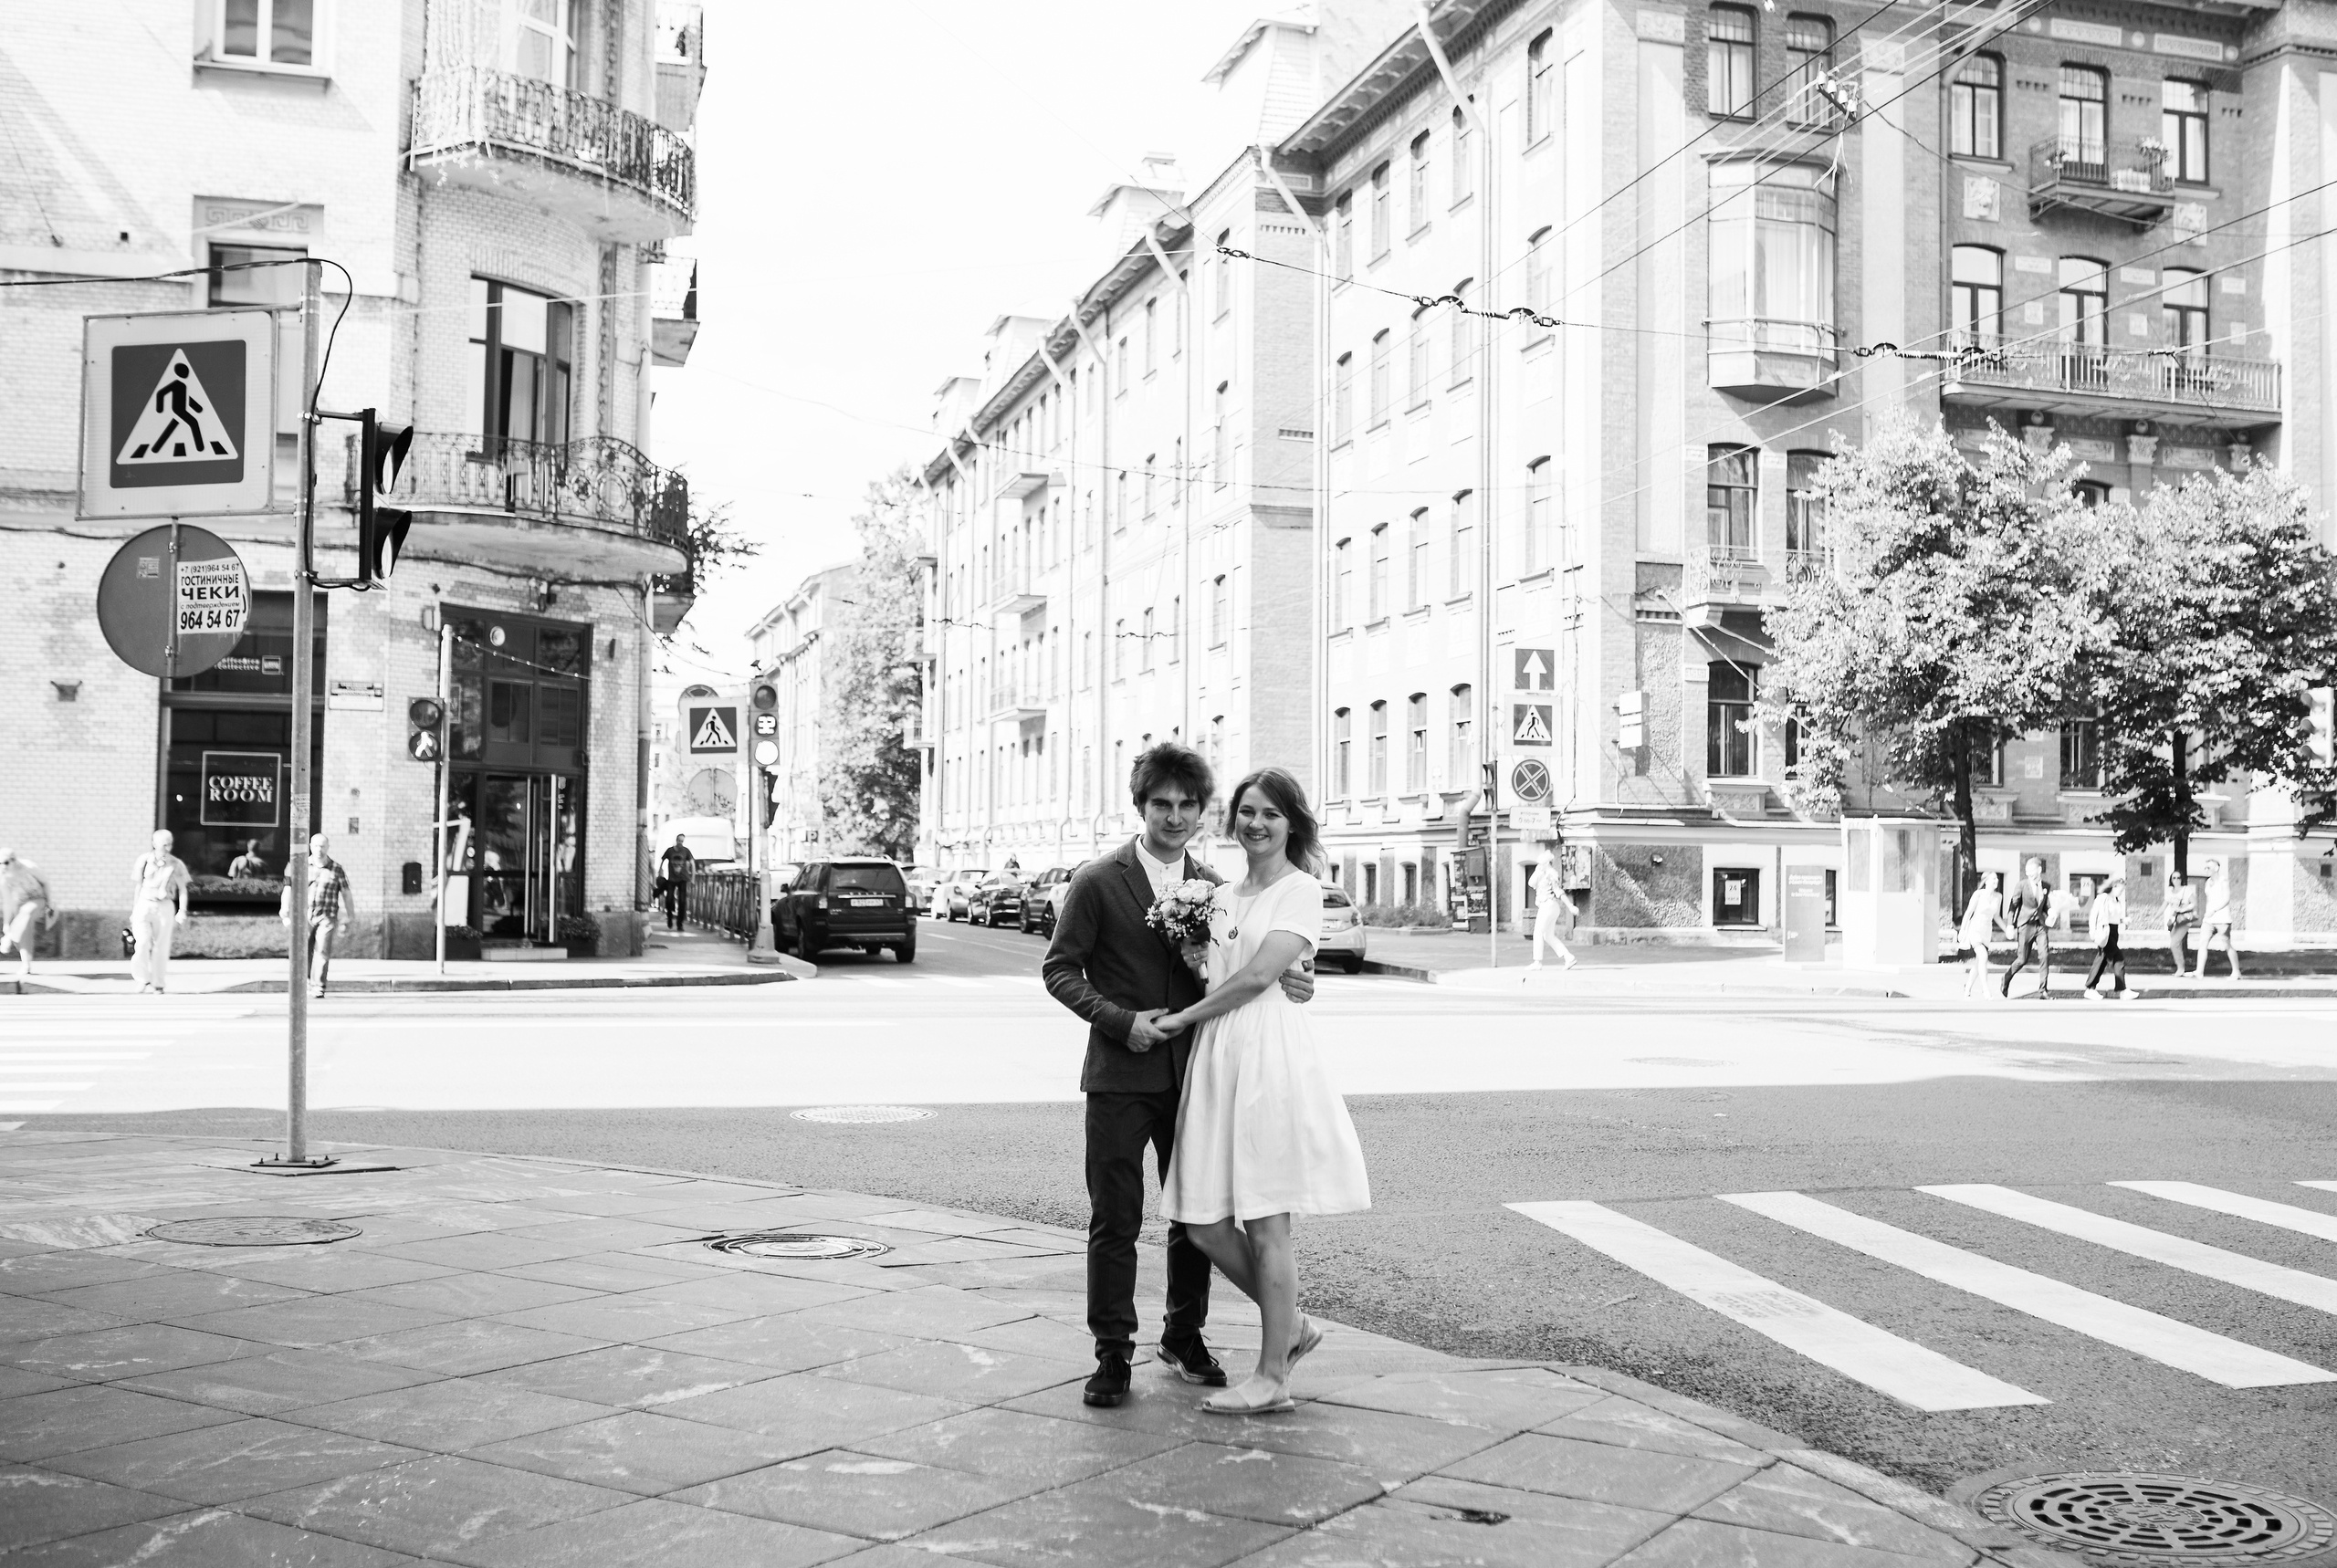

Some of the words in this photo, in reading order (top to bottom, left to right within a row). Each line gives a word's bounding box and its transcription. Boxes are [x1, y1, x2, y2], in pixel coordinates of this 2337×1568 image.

[231, 563, 239, 571] 67
[181, 573, 239, 586] ГОСТИНИЧНЫЕ
[181, 585, 239, 600] ЧЕКИ
[185, 601, 240, 610] подтверждением
[180, 611, 203, 630] 964
[206, 610, 221, 628] 54
[225, 609, 240, 628] 67
[208, 775, 273, 790] COFFEE
[209, 788, 272, 802] ROOM
